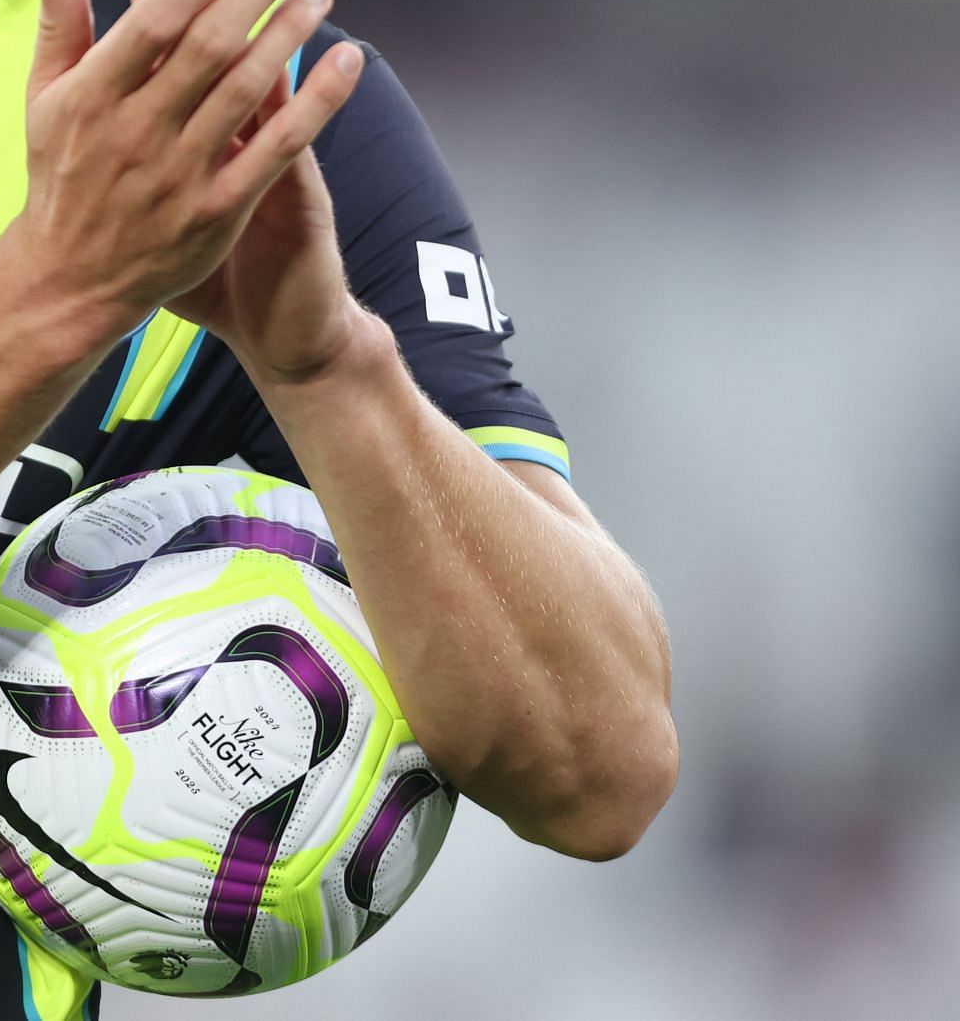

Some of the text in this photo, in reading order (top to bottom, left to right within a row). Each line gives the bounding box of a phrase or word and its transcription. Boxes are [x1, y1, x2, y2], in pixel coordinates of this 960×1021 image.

[254, 705, 280, 731] 2024
[191, 712, 262, 786] FLIGHT
[218, 715, 265, 761] Nike
[188, 739, 206, 759] OFFICIAL
[205, 758, 220, 774] MATCH
[194, 756, 211, 776] PREMIER
[174, 769, 201, 796] 2025
